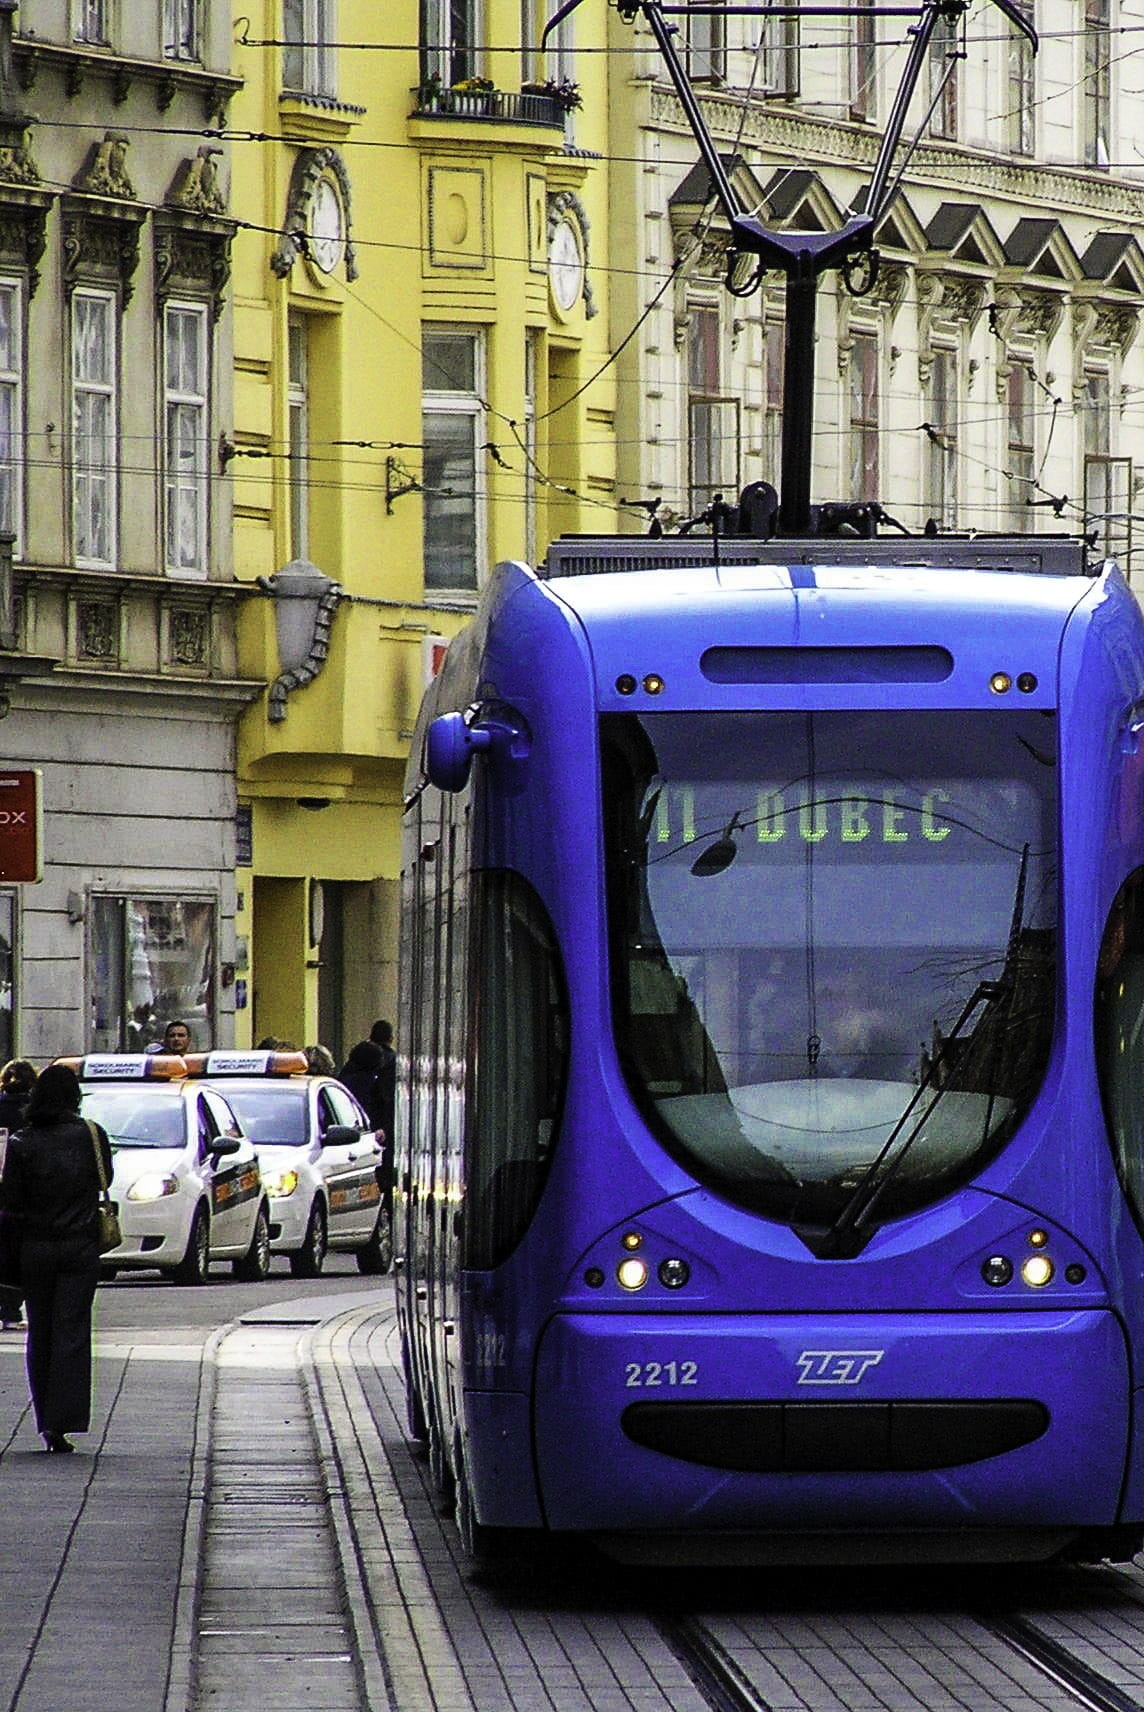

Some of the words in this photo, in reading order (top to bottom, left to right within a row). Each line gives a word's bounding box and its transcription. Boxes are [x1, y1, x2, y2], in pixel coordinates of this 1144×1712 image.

[756, 786, 953, 843] DUBEC
[625, 1361, 698, 1387] 2212
[796, 1350, 885, 1384] ZET
